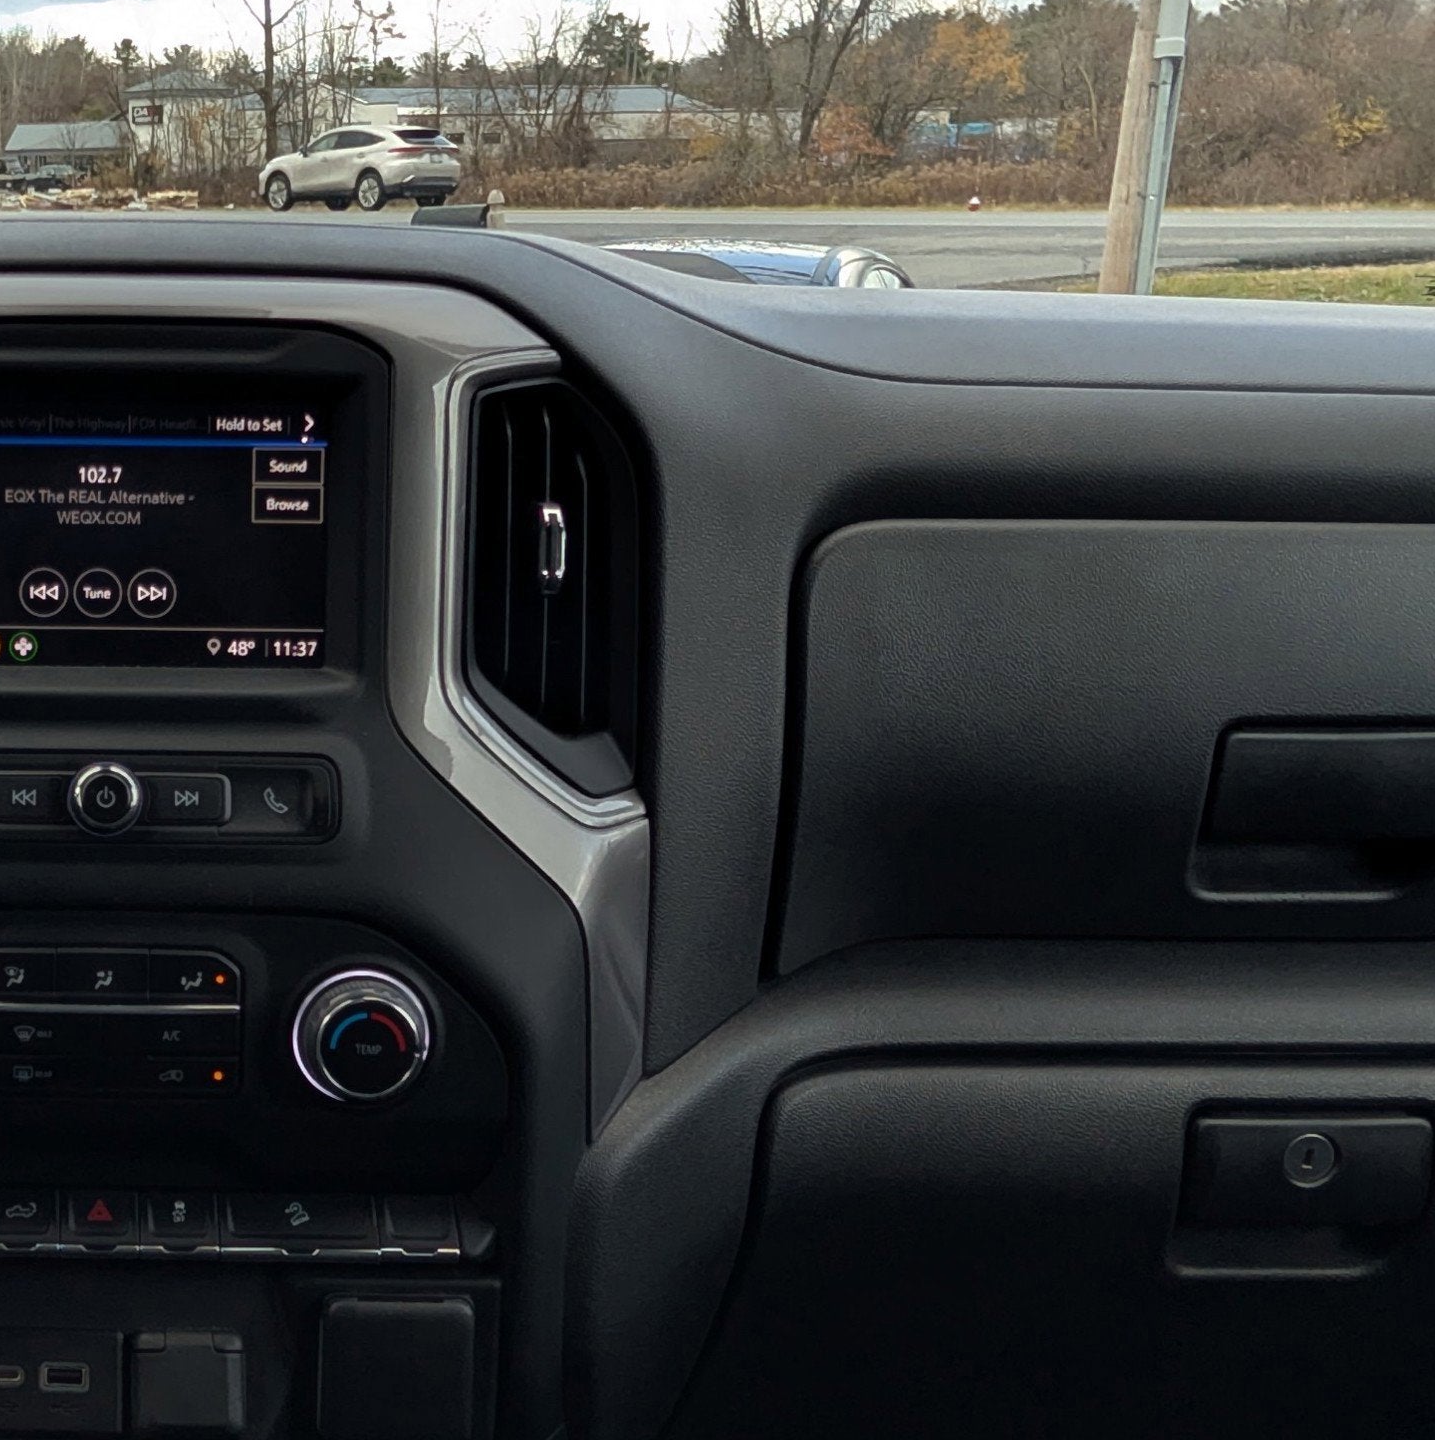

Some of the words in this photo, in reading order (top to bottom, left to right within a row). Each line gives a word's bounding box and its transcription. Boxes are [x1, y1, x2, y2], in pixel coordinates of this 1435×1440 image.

[217, 418, 244, 432] Hold
[247, 419, 260, 432] to
[262, 418, 282, 433] Set
[269, 459, 307, 474] Sound
[79, 467, 122, 484] 102.7
[5, 489, 35, 505] EQX
[39, 490, 64, 504] The
[68, 490, 104, 505] REAL
[108, 490, 185, 505] Alternative
[266, 498, 309, 512] Browse
[57, 510, 141, 526] WEQX.COM
[83, 586, 111, 600] Tune
[228, 640, 255, 656] 48°
[274, 640, 317, 657] 11:37
[162, 1029, 181, 1042] A/C
[355, 1043, 382, 1056] TEMP
